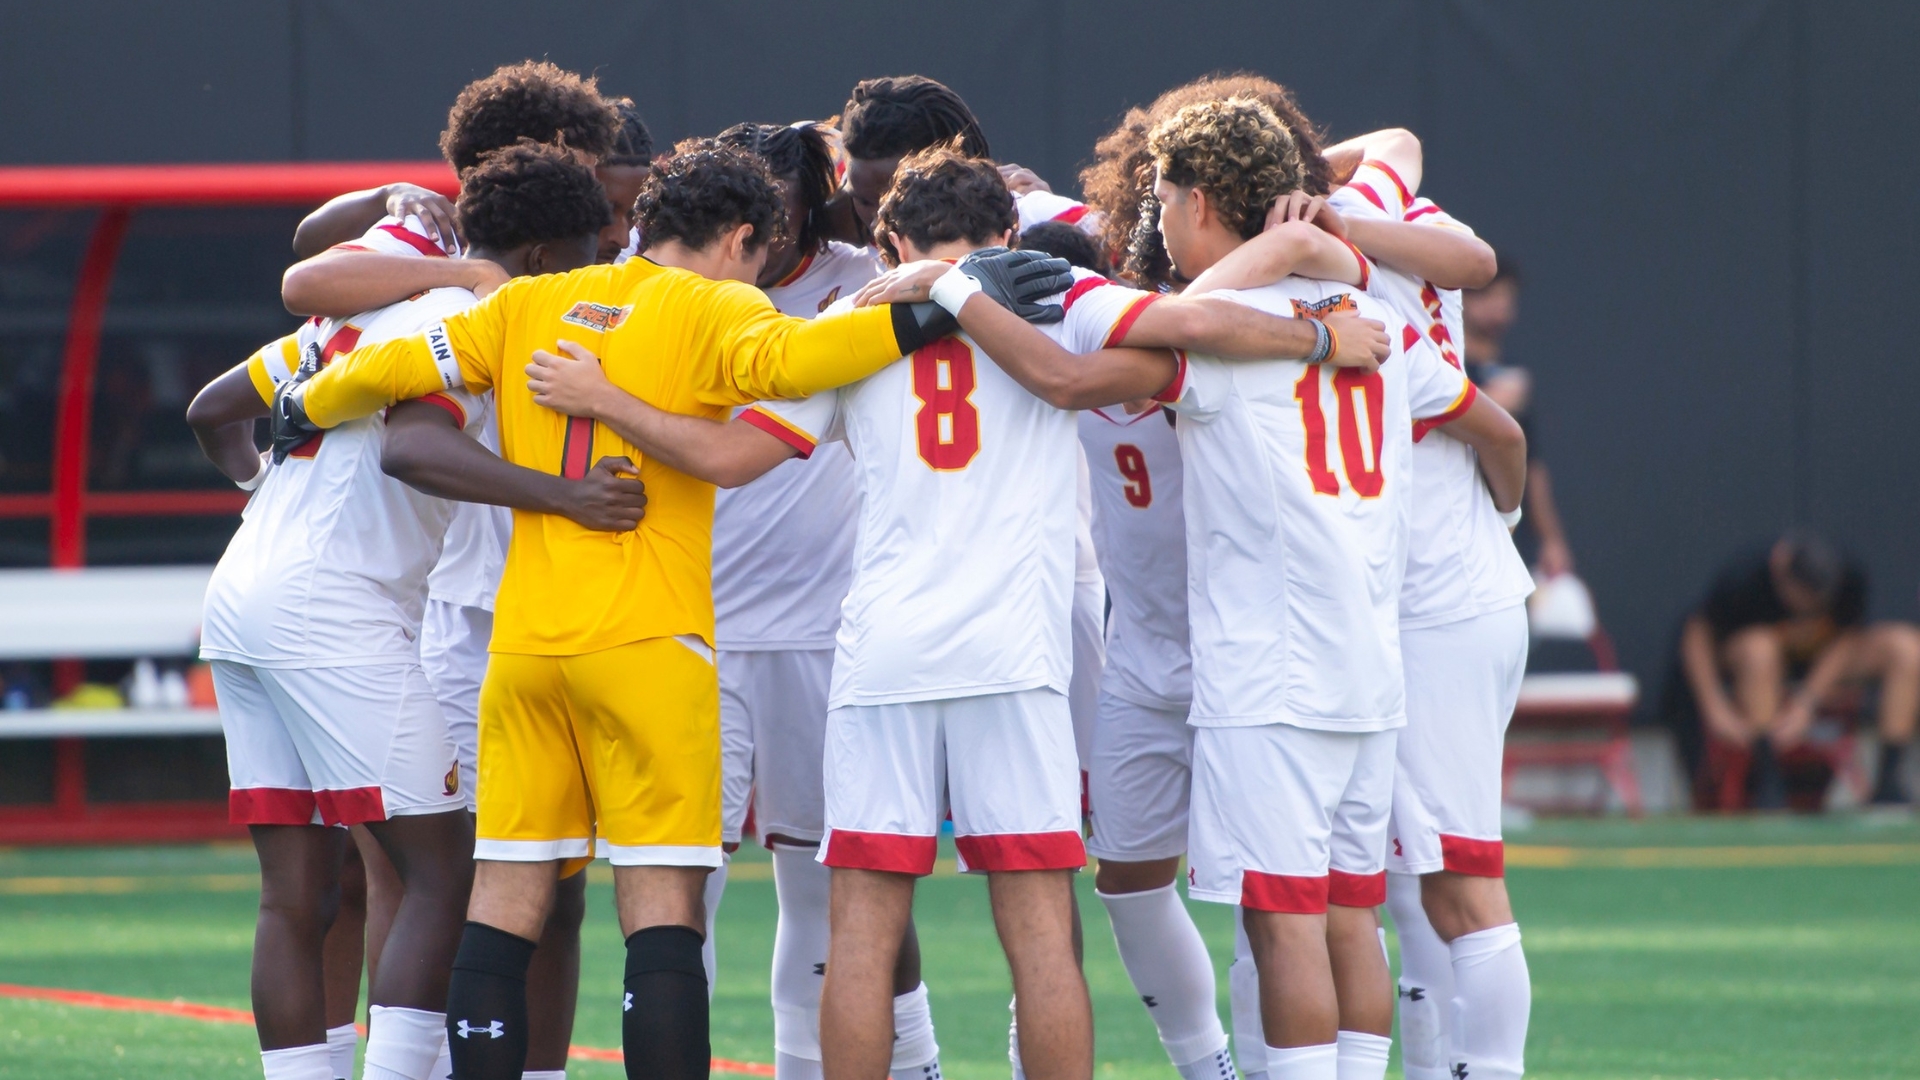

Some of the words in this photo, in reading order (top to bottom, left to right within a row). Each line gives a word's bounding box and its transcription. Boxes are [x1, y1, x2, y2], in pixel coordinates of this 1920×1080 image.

[909, 335, 982, 473] 8
[1293, 362, 1386, 500] 10
[1113, 443, 1154, 510] 9
